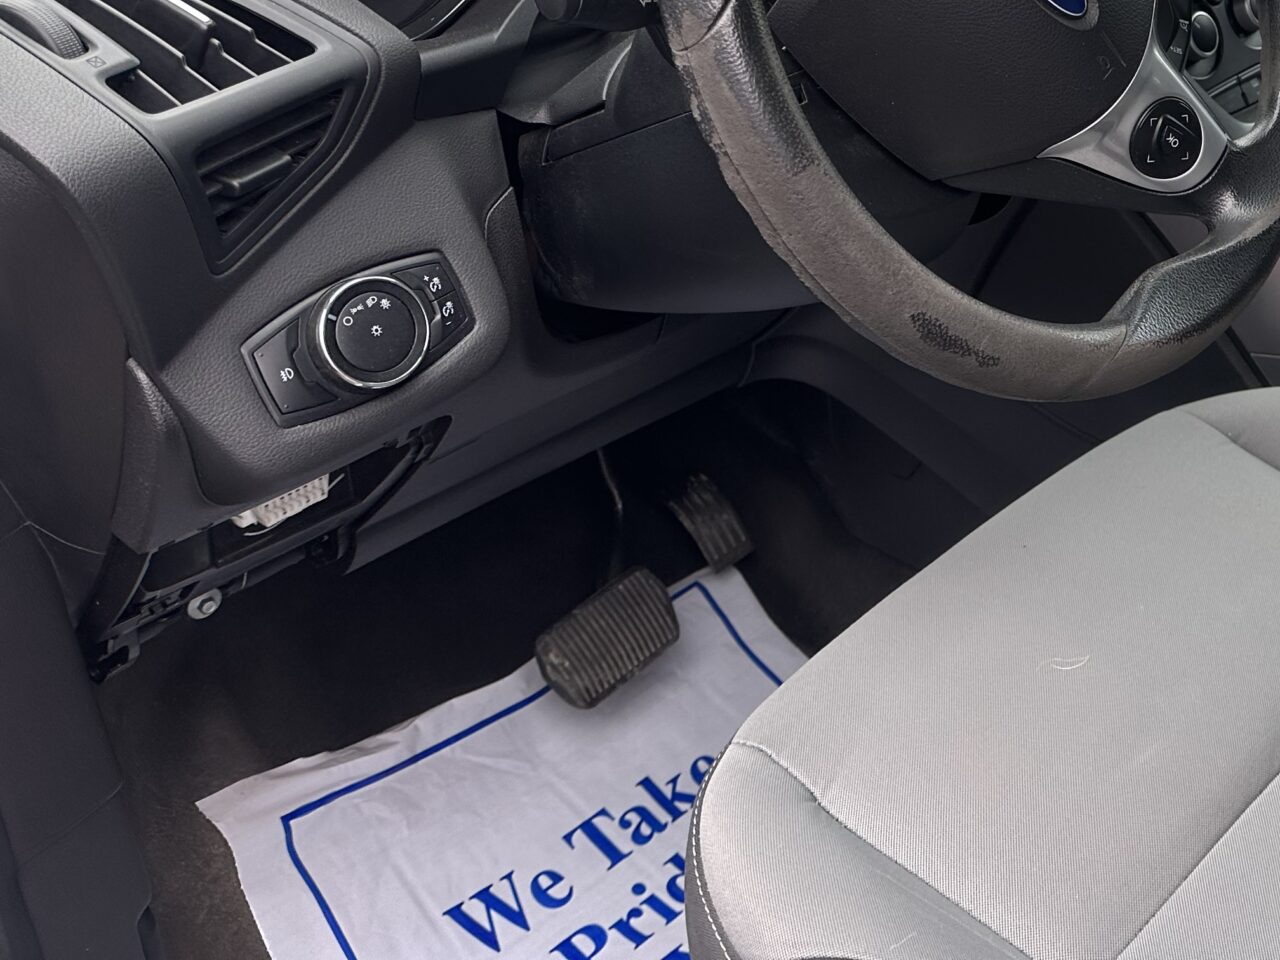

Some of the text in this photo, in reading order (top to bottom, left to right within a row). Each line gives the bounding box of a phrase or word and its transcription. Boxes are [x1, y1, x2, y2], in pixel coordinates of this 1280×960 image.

[1166, 132, 1179, 148] OK
[442, 755, 717, 953] We Take
